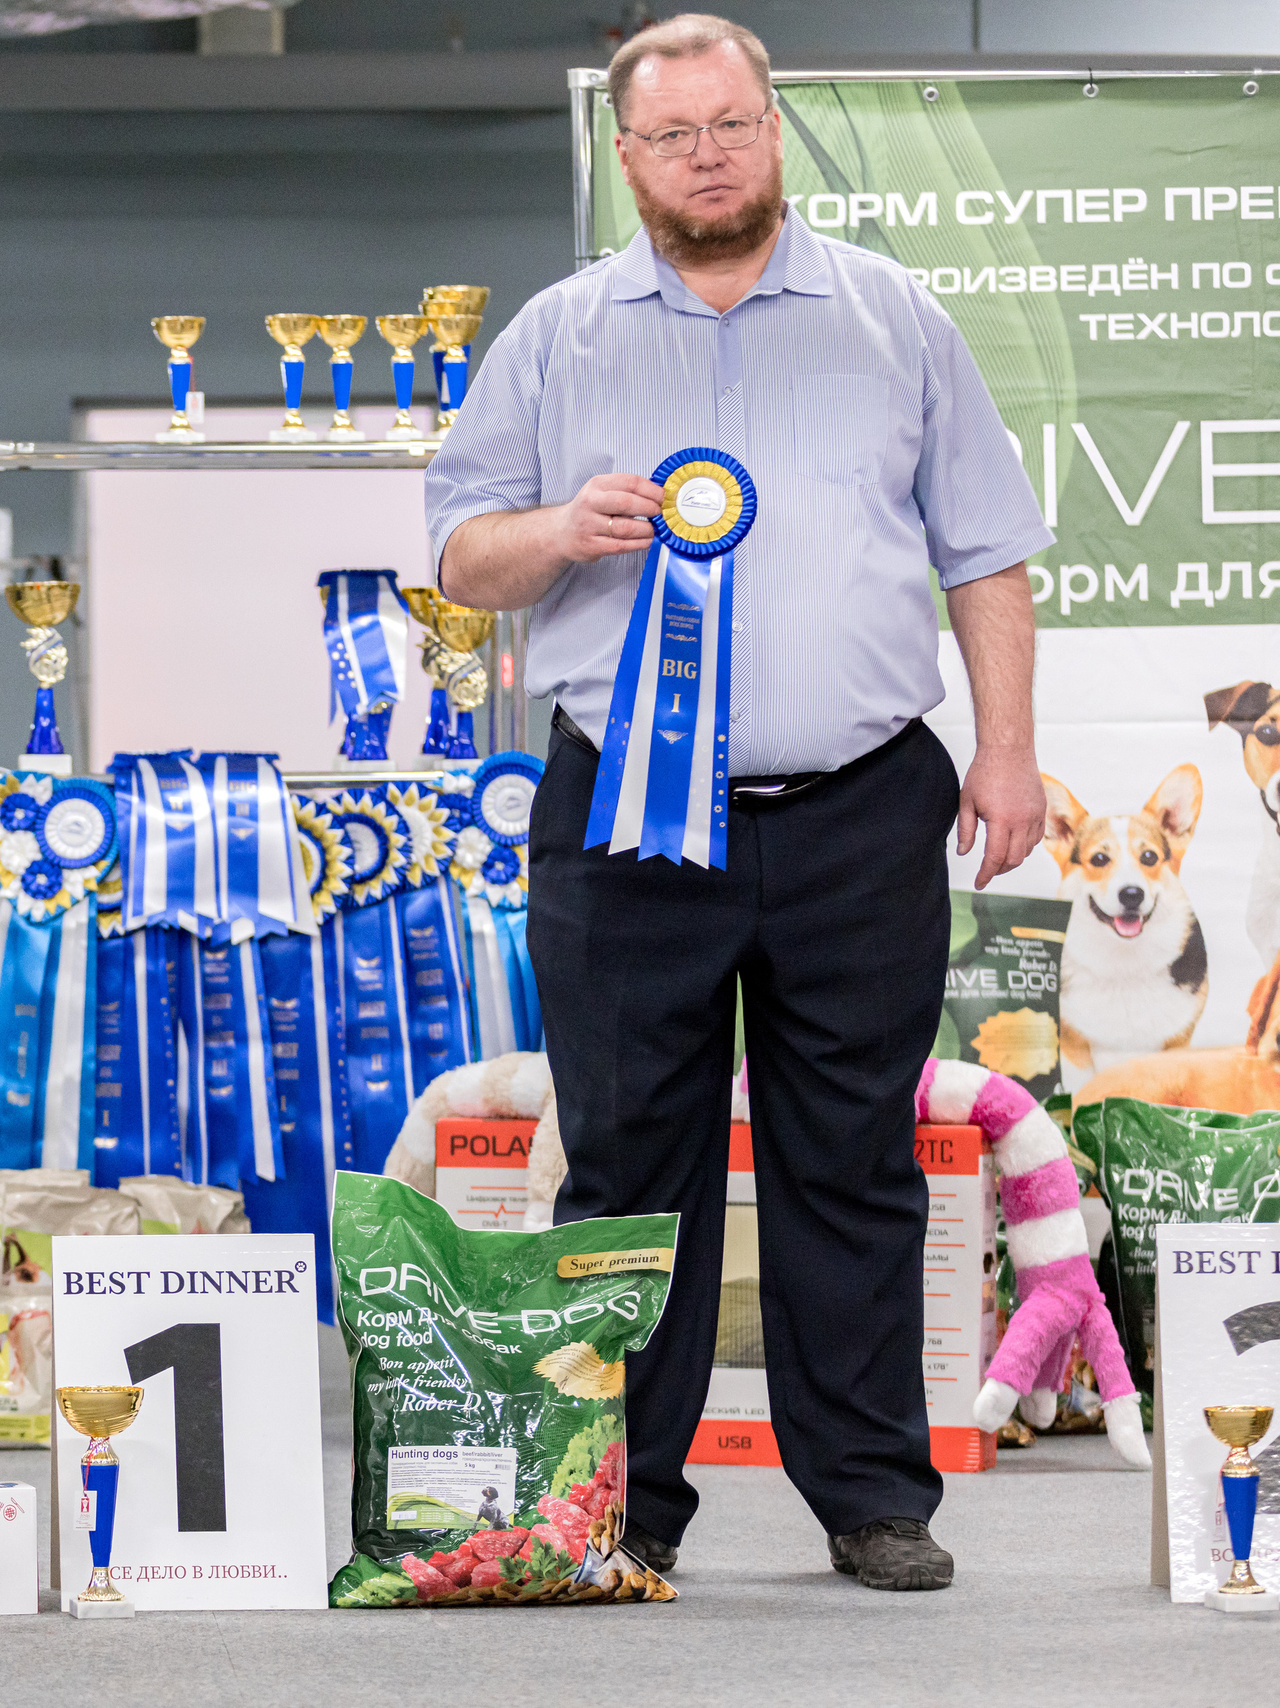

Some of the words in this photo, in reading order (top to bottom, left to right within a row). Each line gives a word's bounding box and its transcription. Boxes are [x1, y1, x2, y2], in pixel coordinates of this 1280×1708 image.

[955, 187, 1148, 225] СУПЕР
[1164, 186, 1280, 222] ПРЕ
[1192, 261, 1252, 289] ПО
[1006, 420, 1280, 528] IVE
[661, 658, 698, 680] BIG
[671, 693, 682, 713] I
[1007, 970, 1058, 993] DOG
[450, 1134, 533, 1157] POLA
[569, 1257, 605, 1272] Super
[608, 1254, 660, 1269] premium
[1172, 1250, 1261, 1275] BEST
[63, 1271, 151, 1295] BEST
[160, 1270, 300, 1294] DINNER
[358, 1262, 503, 1334] DRIVE
[520, 1290, 641, 1336] DOG
[357, 1308, 414, 1332] Корм
[361, 1331, 391, 1350] dog
[396, 1327, 433, 1346] food
[407, 1355, 455, 1374] appetit
[367, 1382, 384, 1396] my
[401, 1391, 458, 1412] Rober
[461, 1392, 486, 1412] D.
[123, 1323, 227, 1533] 1
[718, 1436, 752, 1449] USB
[391, 1450, 430, 1460] Hunting
[432, 1449, 459, 1460] dogs
[109, 1566, 133, 1580] СЕ
[137, 1565, 187, 1582] ДЕЛО
[192, 1566, 203, 1578] В
[208, 1565, 288, 1579] ЛЮБВИ..
